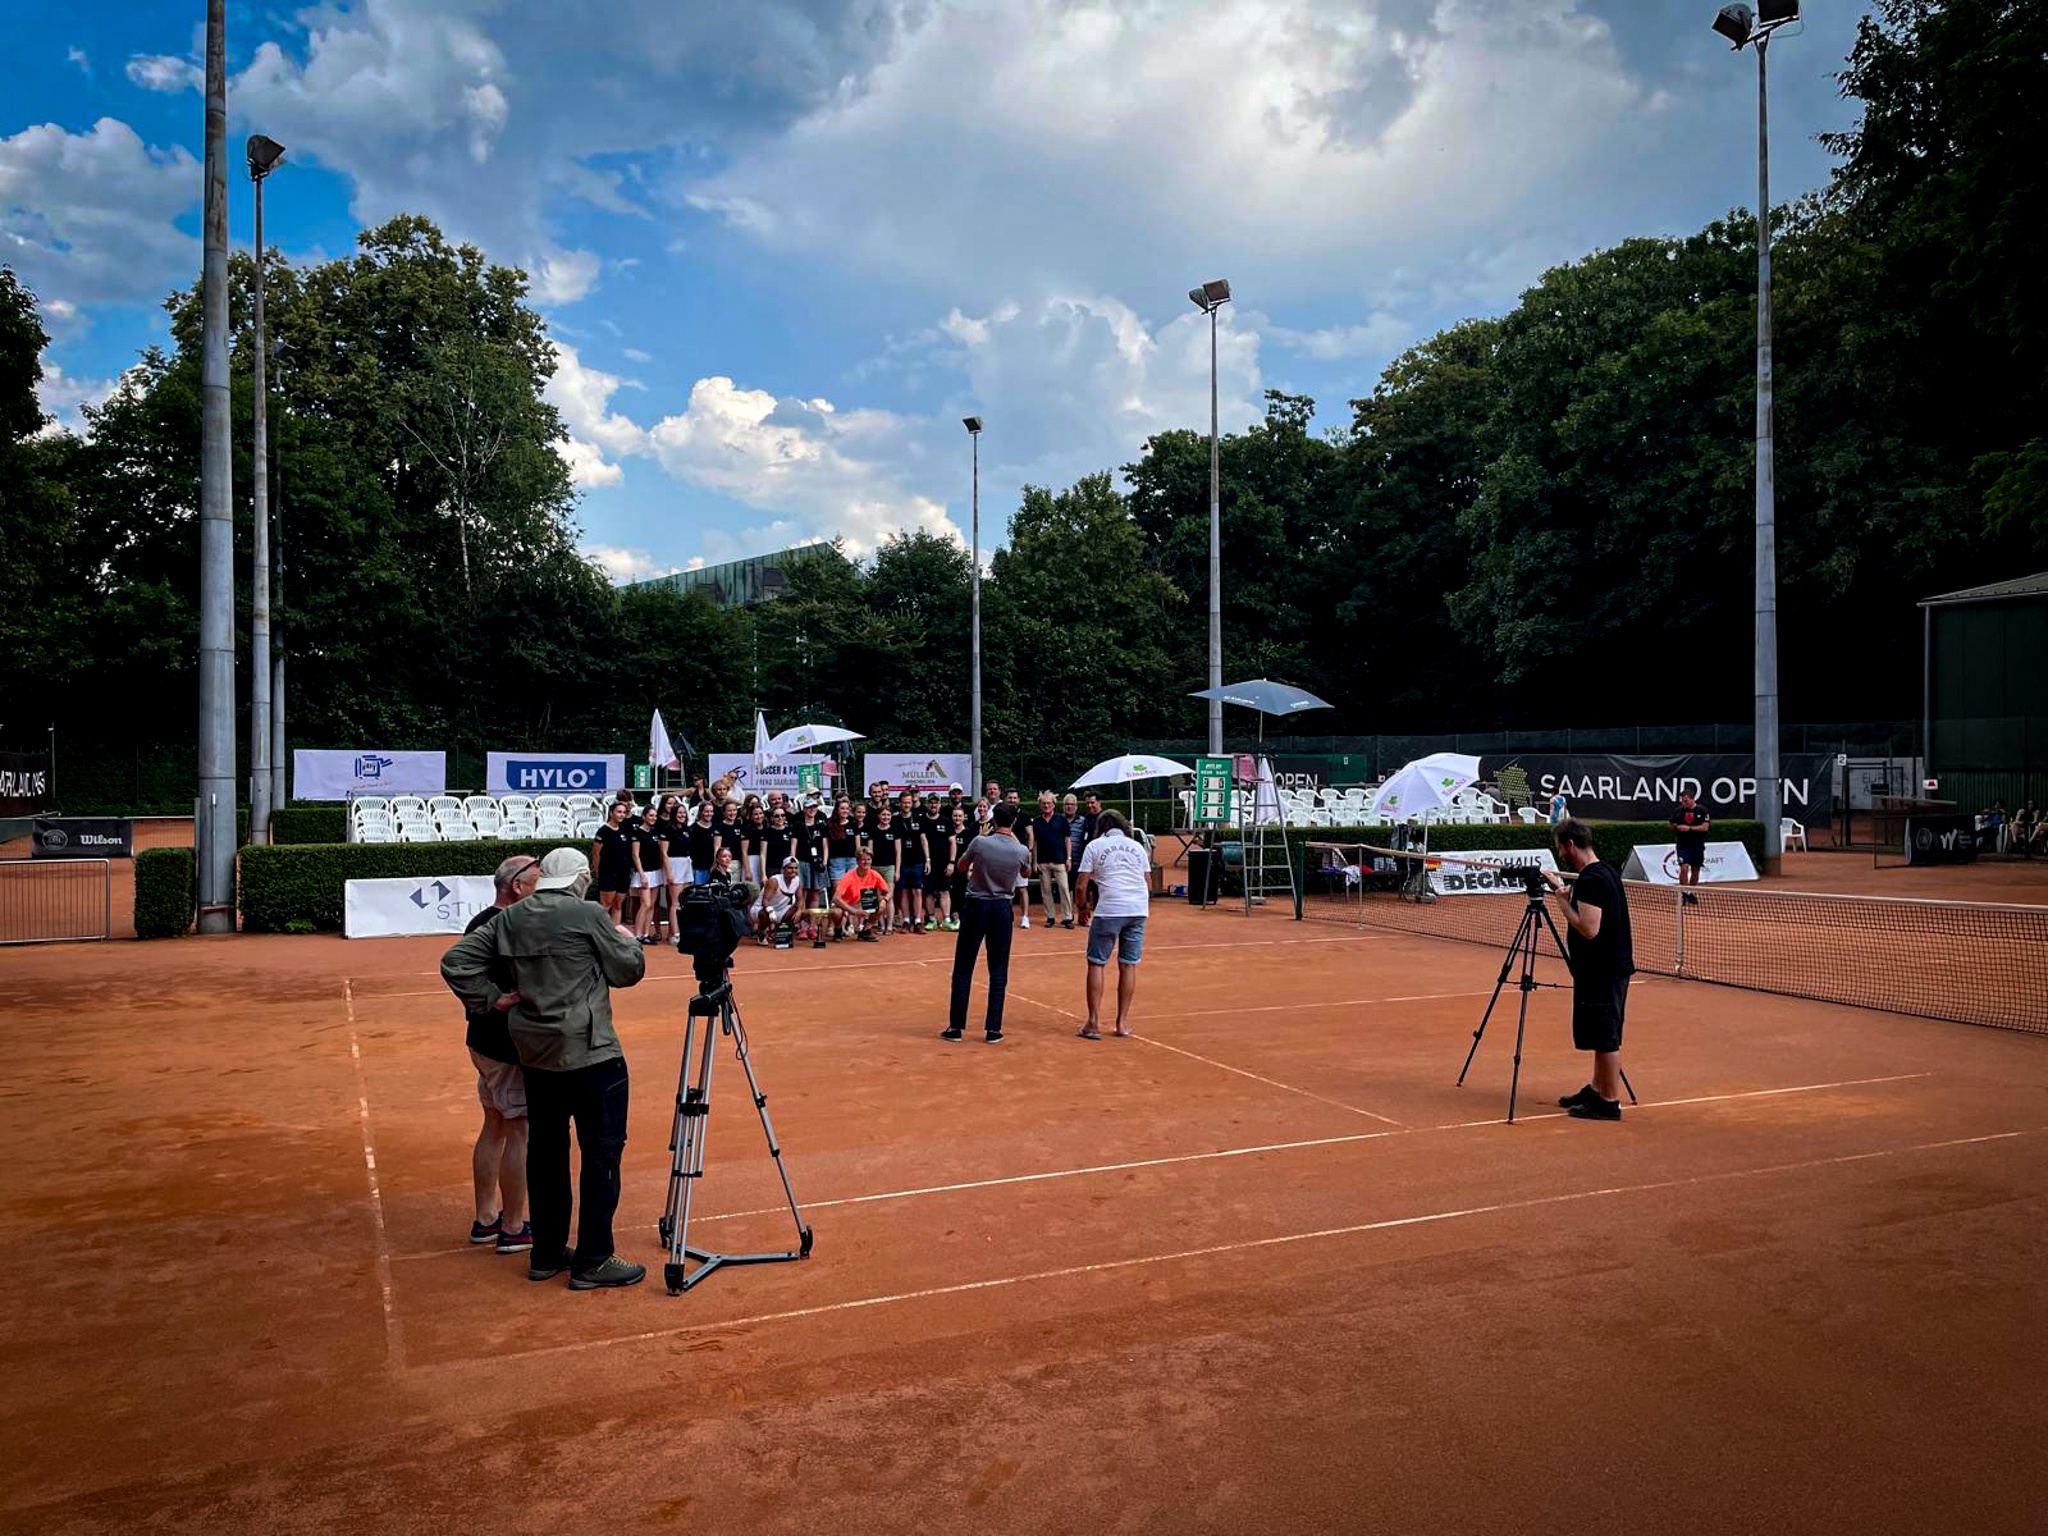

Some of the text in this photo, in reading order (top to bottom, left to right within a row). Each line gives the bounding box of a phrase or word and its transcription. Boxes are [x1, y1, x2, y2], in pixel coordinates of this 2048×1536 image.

[520, 768, 588, 788] HYLO
[1540, 774, 1809, 805] SAARLAND OPN
[80, 834, 123, 845] Wilson
[1443, 871, 1527, 891] DECKE
[437, 901, 488, 920] STU
